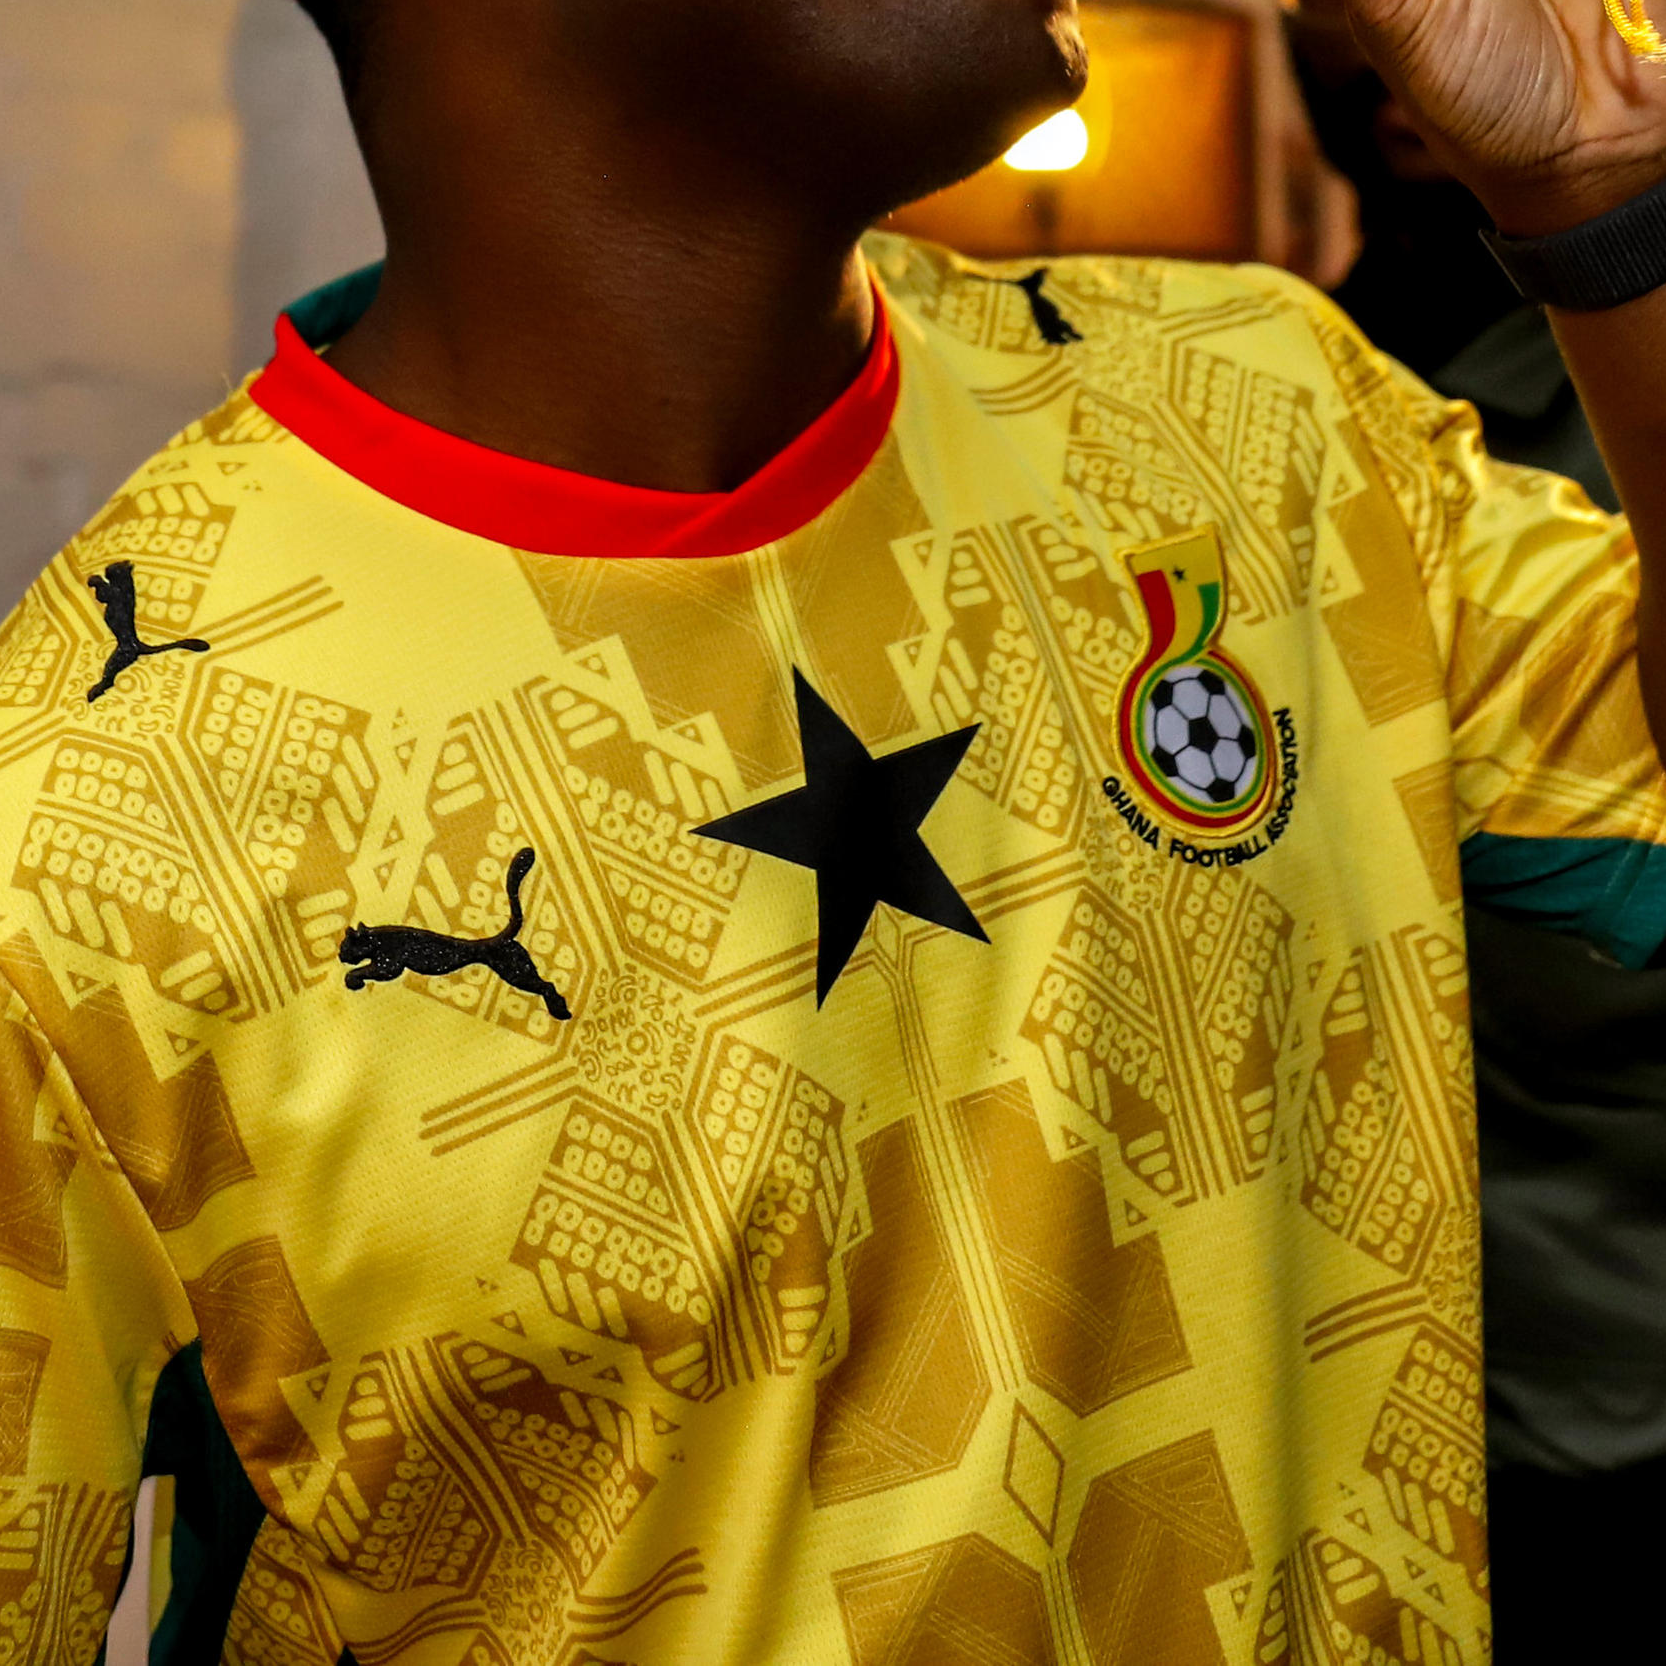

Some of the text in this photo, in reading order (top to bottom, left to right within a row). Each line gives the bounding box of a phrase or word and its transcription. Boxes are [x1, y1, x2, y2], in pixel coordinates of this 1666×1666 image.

[1103, 707, 1299, 867] GHANA FOOTBALL ASSOCIATION
